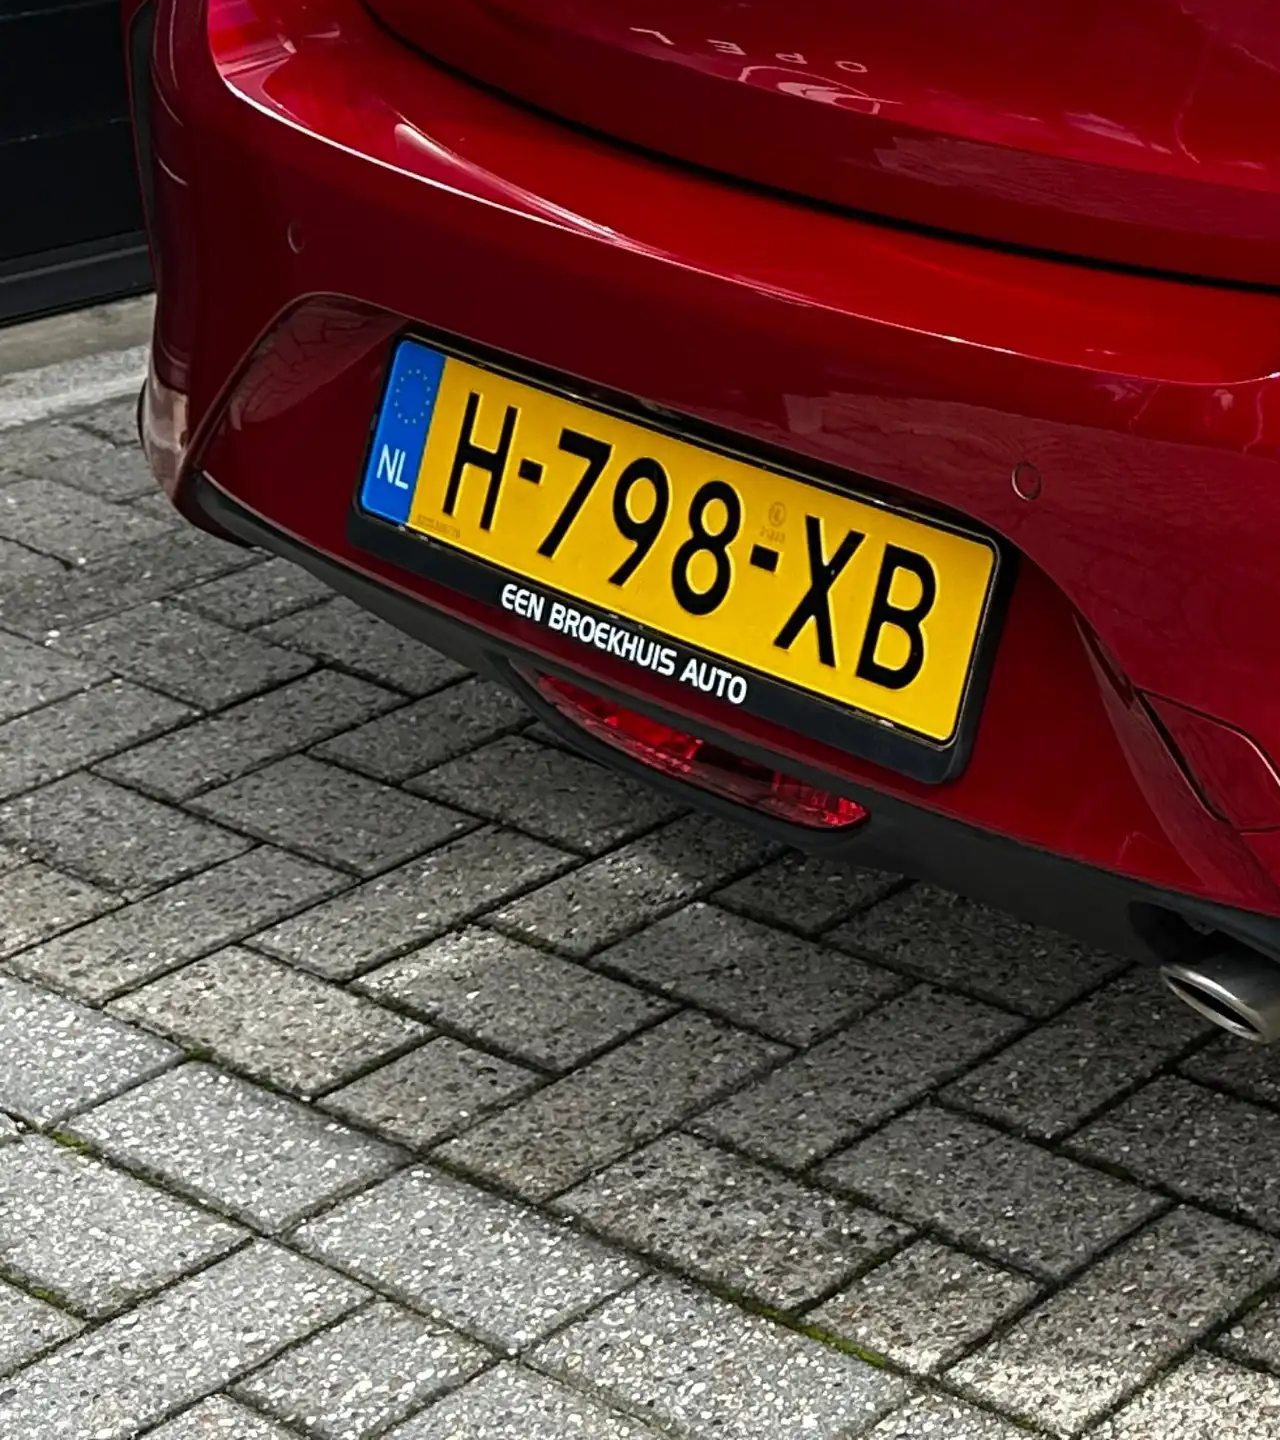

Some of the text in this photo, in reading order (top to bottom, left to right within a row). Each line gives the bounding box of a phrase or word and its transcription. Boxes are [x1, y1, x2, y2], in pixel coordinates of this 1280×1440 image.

[376, 443, 409, 490] NL
[442, 391, 937, 691] H-798-XB
[501, 583, 748, 704] EEN BROEKHUIS AUTO
